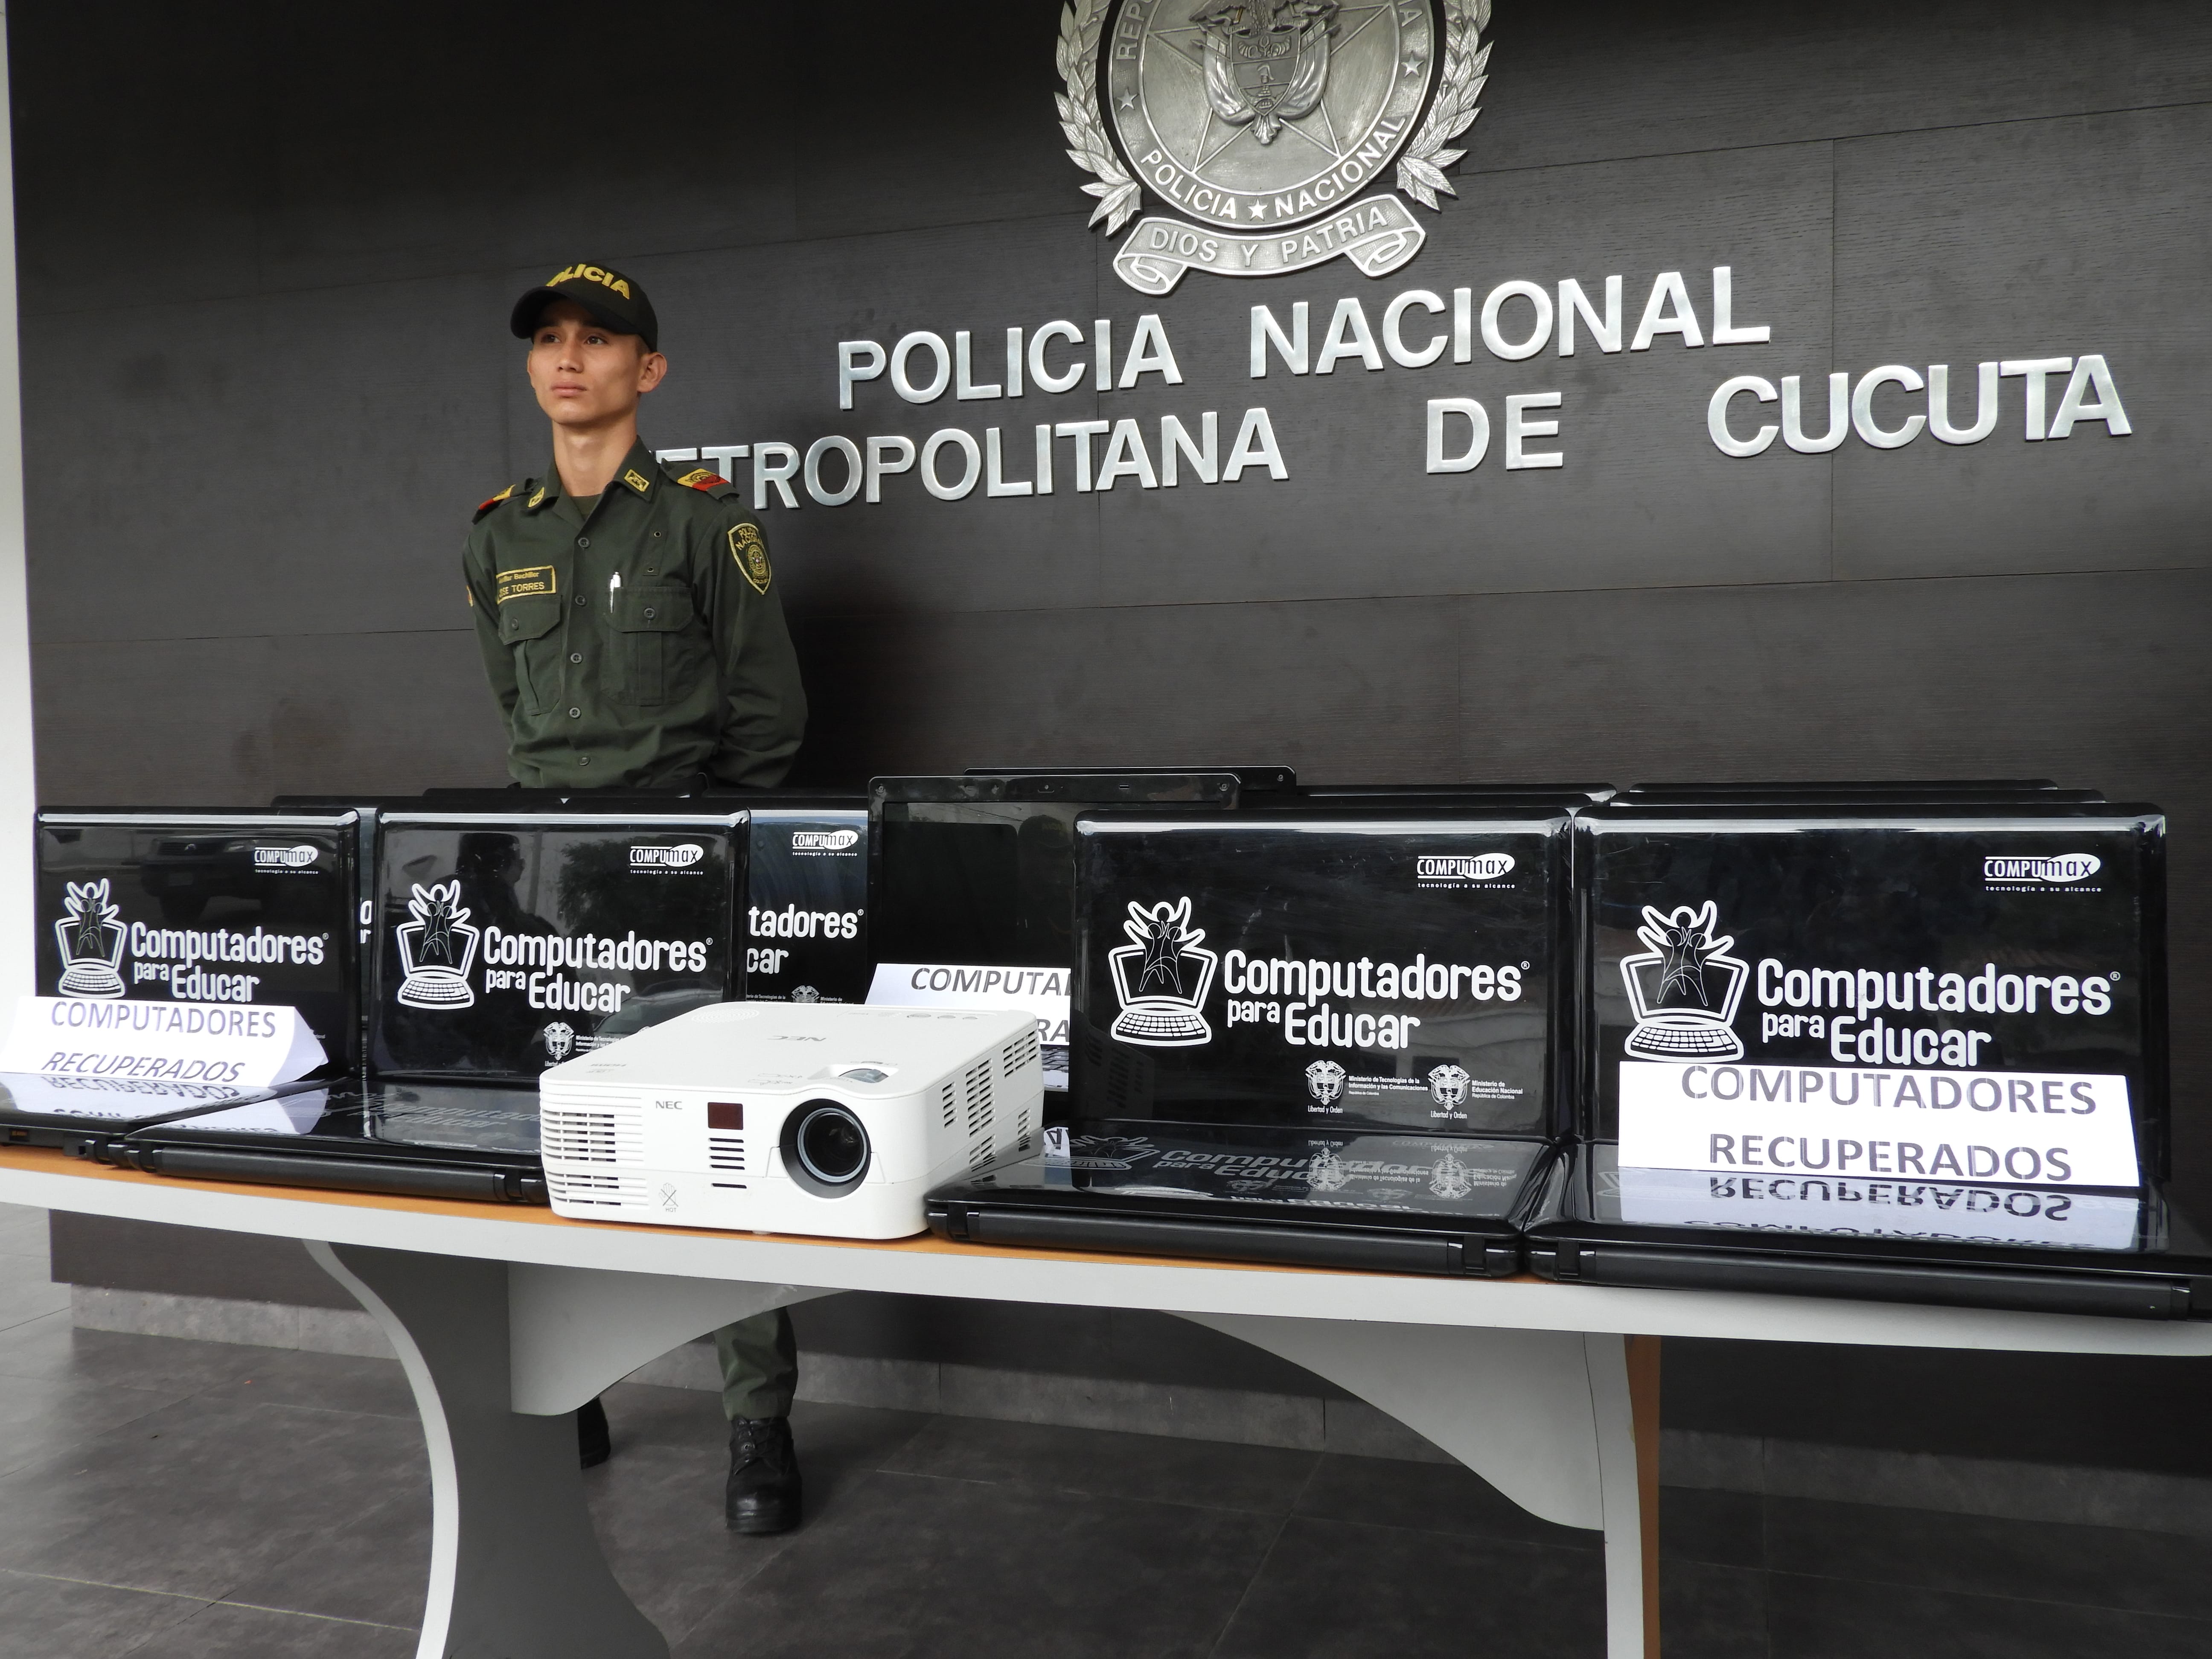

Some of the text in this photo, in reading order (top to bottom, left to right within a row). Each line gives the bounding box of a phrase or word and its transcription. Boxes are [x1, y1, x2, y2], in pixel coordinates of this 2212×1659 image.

[1141, 115, 1407, 219] POLICIA NACIONAL
[1150, 207, 1388, 267] DIOS Y PATRIA
[839, 266, 1770, 410] POLICIA NACIONAL
[656, 354, 2132, 509] TROPOLITANA DE CUCUTA
[511, 581, 545, 593] TORRES
[134, 961, 260, 1003] para Educar
[486, 968, 631, 1013] para Educar
[911, 967, 1071, 996] COMPUTA
[51, 1001, 276, 1038] COMPUTADORES
[1227, 998, 1421, 1050] para Educar
[1762, 1010, 1992, 1067] para Educar
[41, 1051, 246, 1083] RECUPERADOS
[1681, 1065, 2097, 1115] COMPUTADORES
[655, 1100, 683, 1110] NEC
[1153, 1160, 1215, 1170] para
[1709, 1132, 2072, 1182] RECUPERADOS
